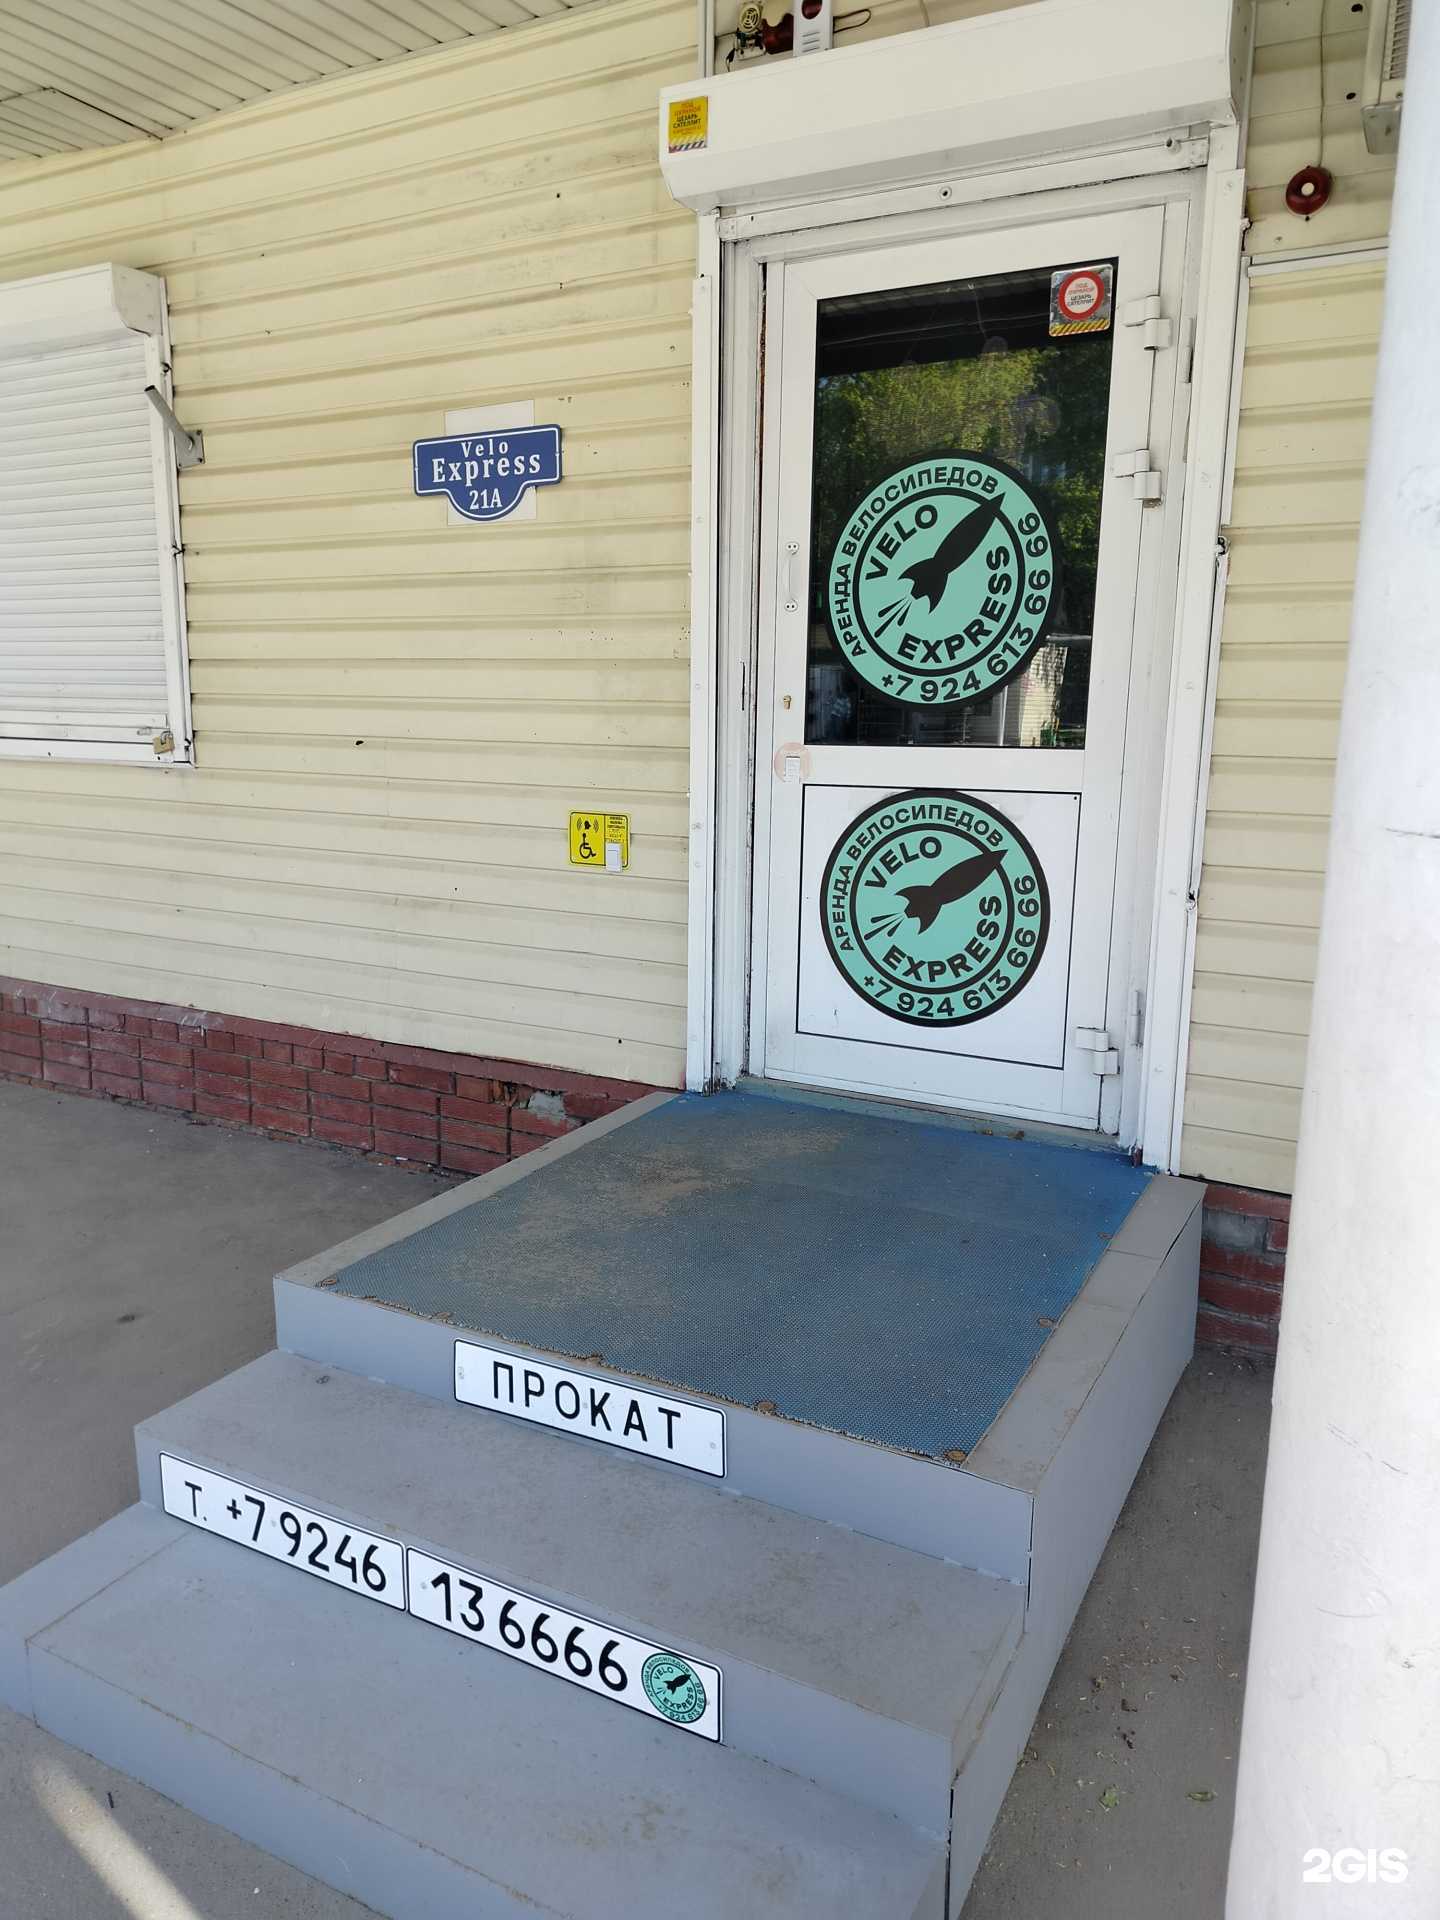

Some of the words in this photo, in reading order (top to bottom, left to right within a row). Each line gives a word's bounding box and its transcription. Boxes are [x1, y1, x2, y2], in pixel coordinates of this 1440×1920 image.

[461, 438, 509, 458] Velo
[432, 454, 541, 487] Express
[841, 466, 999, 557] ВЕЛОСИПЕДОВ
[865, 504, 938, 581] VELO
[1017, 512, 1048, 557] 66
[834, 563, 867, 658] АРЕНДА
[897, 546, 1011, 664] EXPRESS
[1024, 569, 1051, 615] 66
[986, 622, 1035, 676] 613
[882, 674, 914, 697] +7
[920, 670, 981, 702] 924
[831, 864, 855, 952] АРЕНДА
[846, 804, 1004, 861] ВЕЛОСИПЕДОВ
[864, 836, 942, 889] VELO
[1014, 875, 1039, 917] 66
[880, 895, 1003, 982] EXPRESS
[1006, 928, 1036, 968] 66
[863, 975, 893, 999] +7
[897, 992, 955, 1017] 924
[962, 969, 1011, 1011] 613
[493, 1361, 681, 1449] ПРОКАТ
[653, 1666, 674, 1680] VELO
[663, 1686, 694, 1711] EXPRESS
